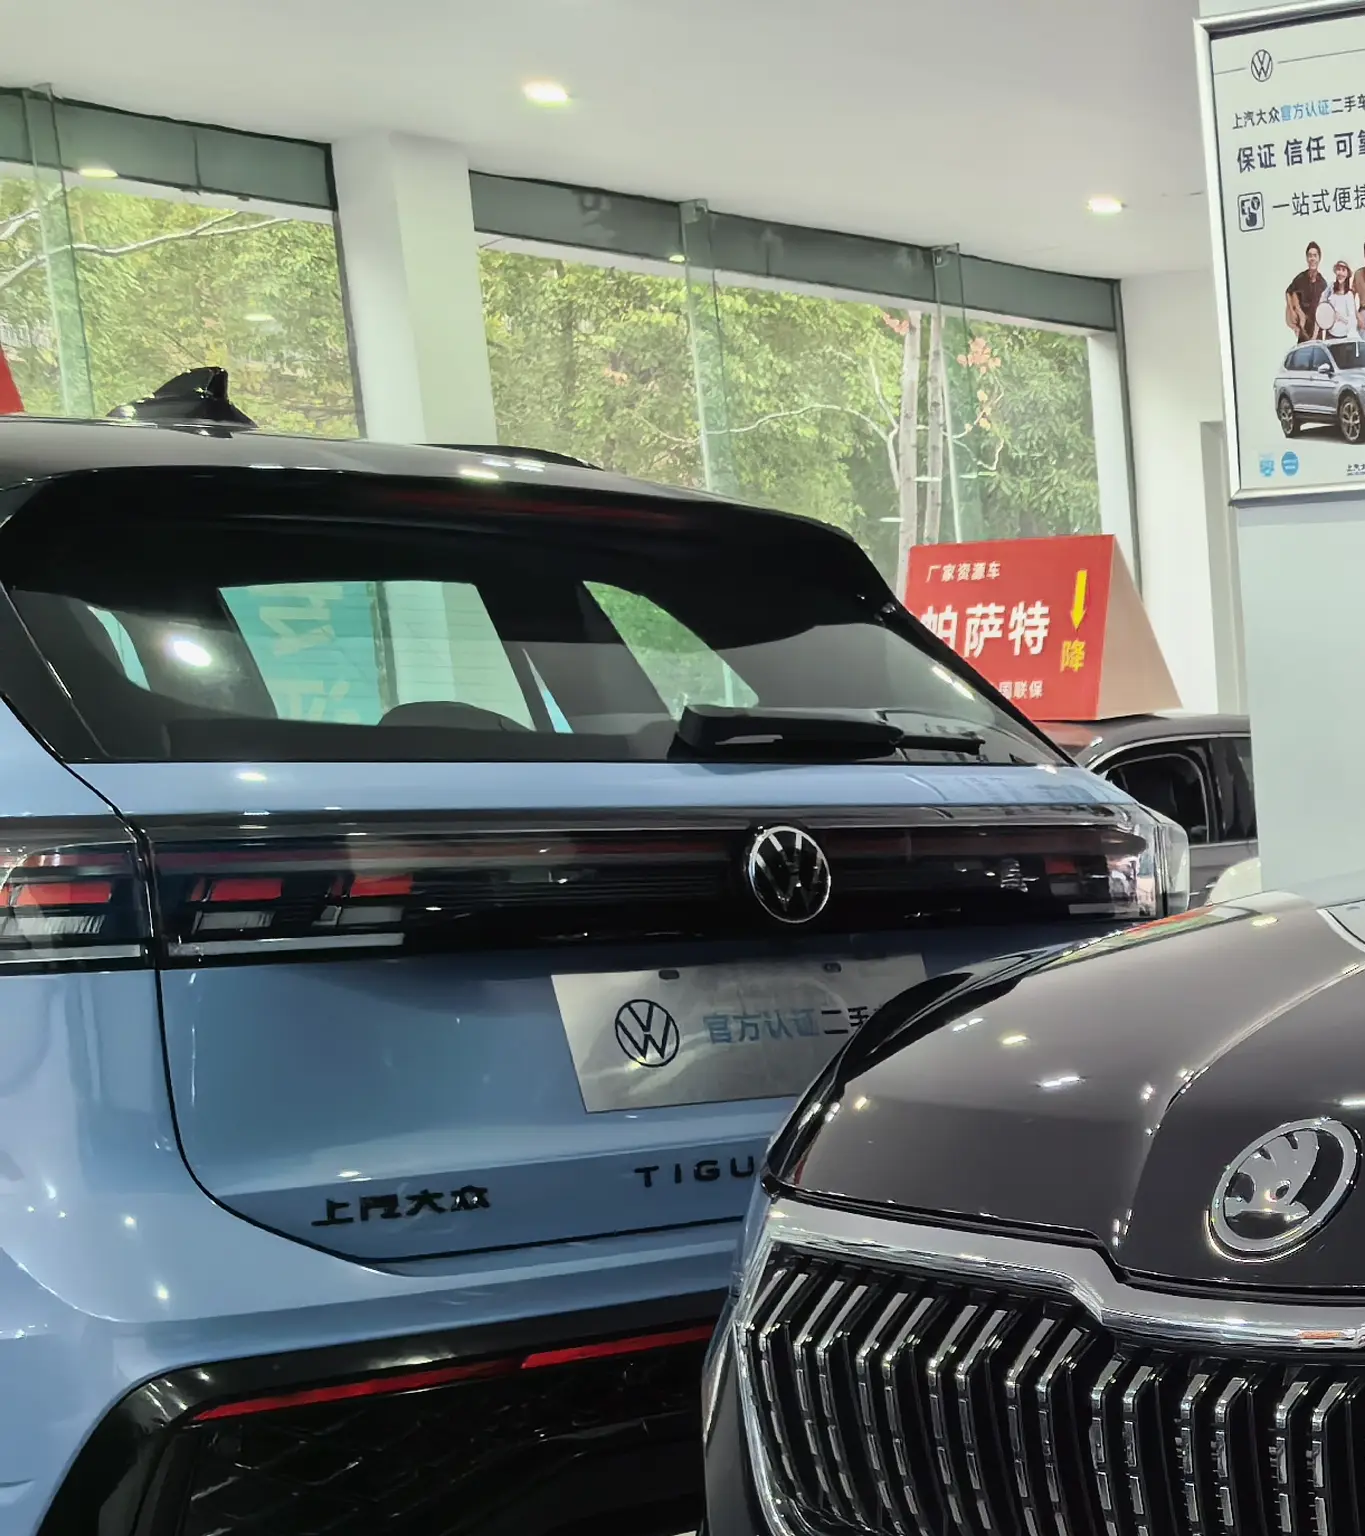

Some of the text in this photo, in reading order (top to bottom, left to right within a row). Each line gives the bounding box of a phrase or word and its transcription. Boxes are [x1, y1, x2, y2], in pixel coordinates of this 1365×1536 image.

[1237, 143, 1276, 173] 保证
[1284, 136, 1325, 167] 信任
[926, 561, 1001, 583] 厂家资源车
[920, 600, 1050, 659] 帕萨特
[1060, 637, 1086, 673] 降
[995, 680, 1043, 700] 国联保
[703, 1005, 884, 1044] 官方认证二手
[311, 1186, 490, 1226] 上汽大众
